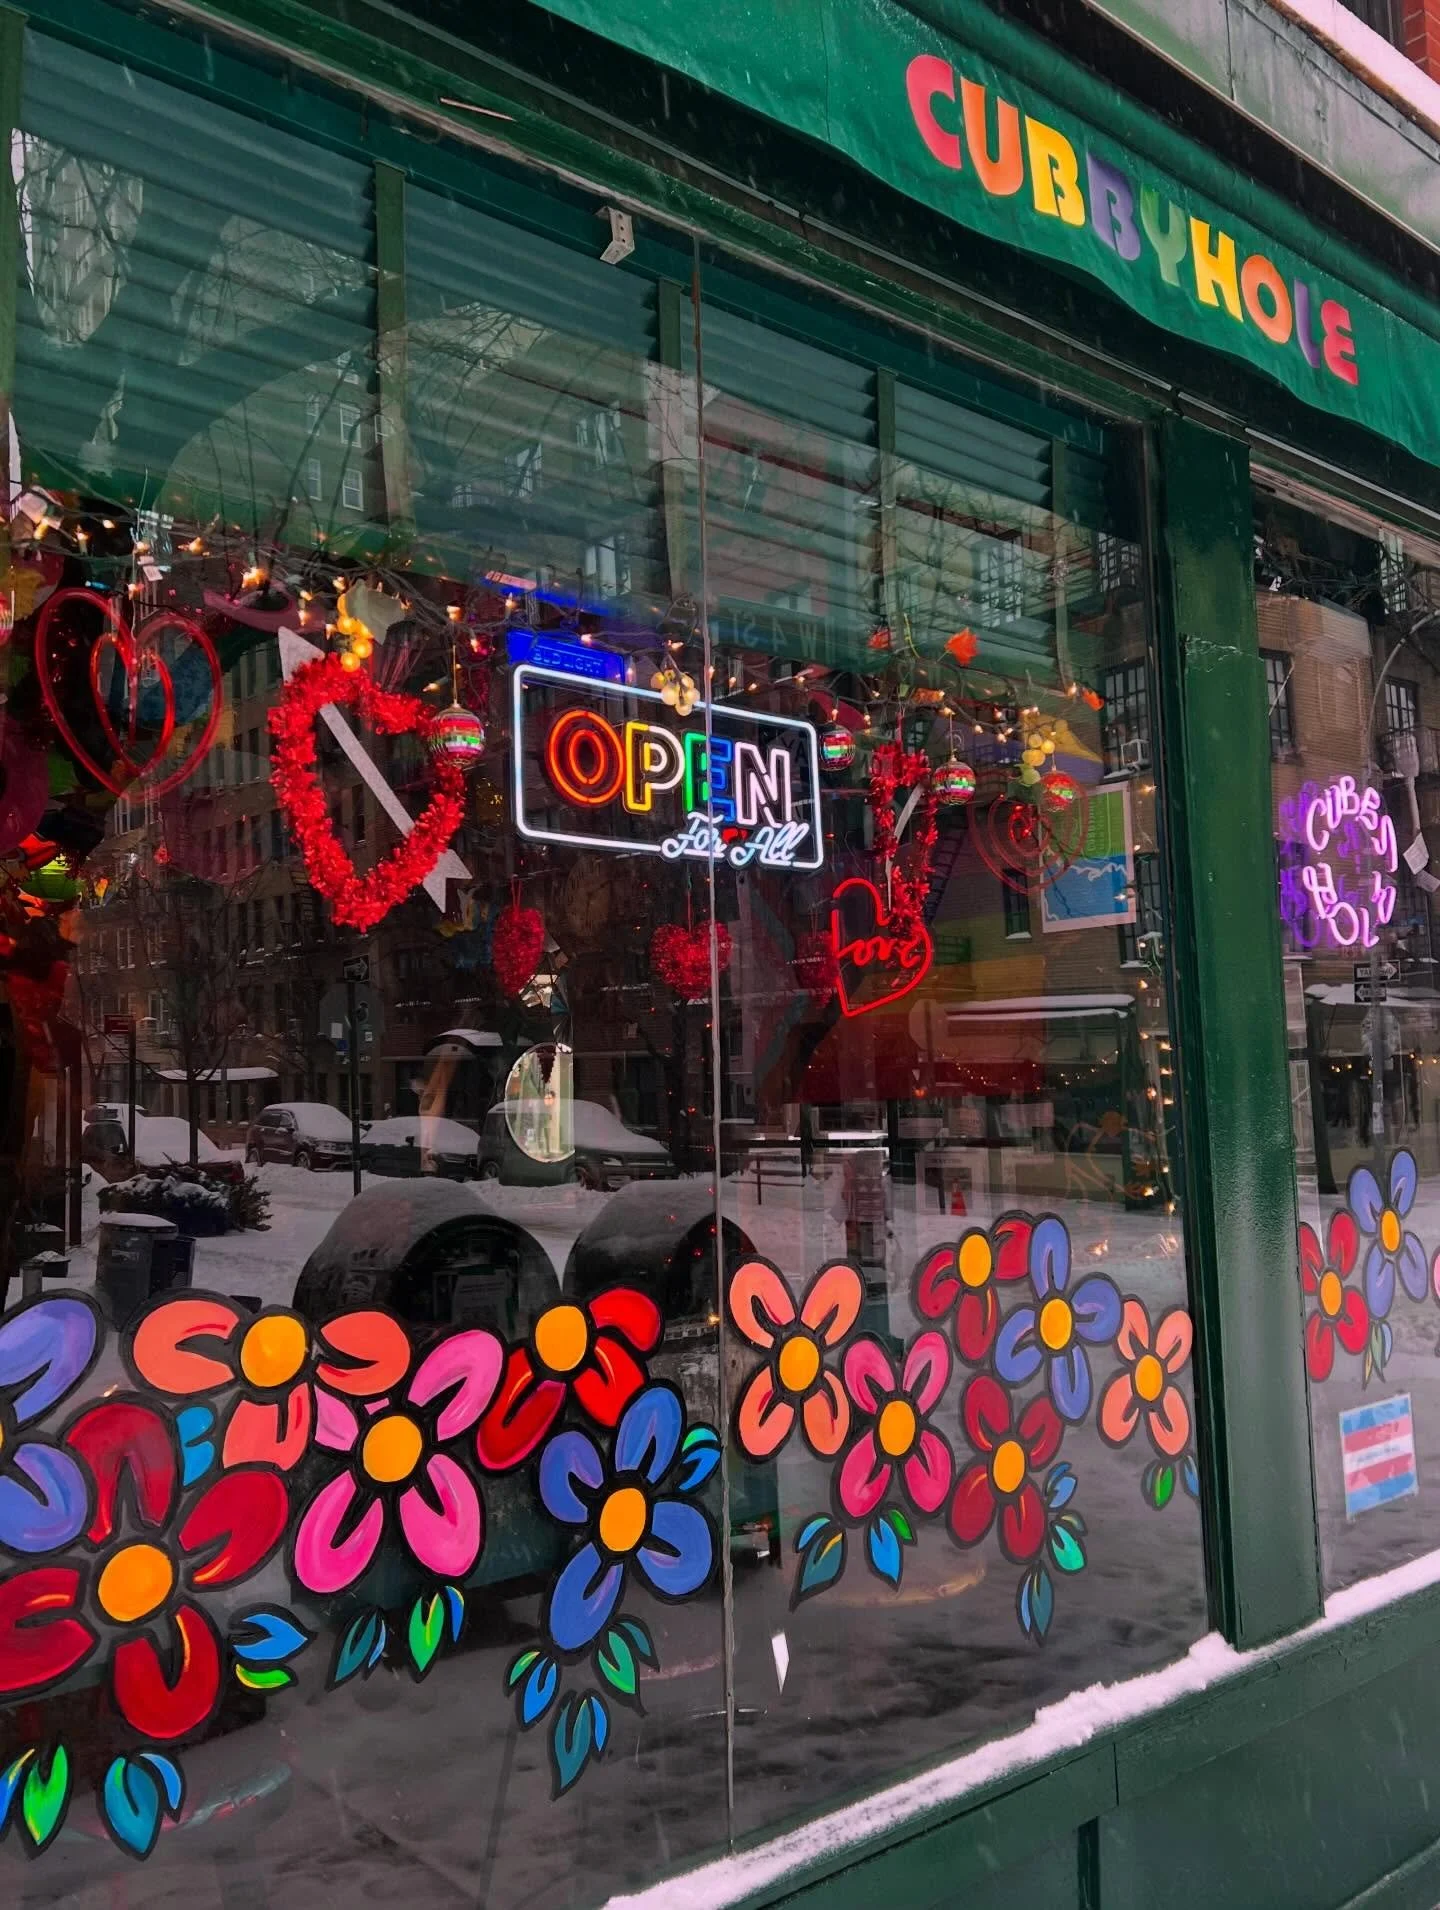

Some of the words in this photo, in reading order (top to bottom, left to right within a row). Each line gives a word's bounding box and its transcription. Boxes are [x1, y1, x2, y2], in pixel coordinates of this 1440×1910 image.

[906, 54, 1359, 386] CUBBYHOLE
[548, 709, 793, 829] OPEN
[661, 811, 728, 860] For
[730, 822, 811, 867] All
